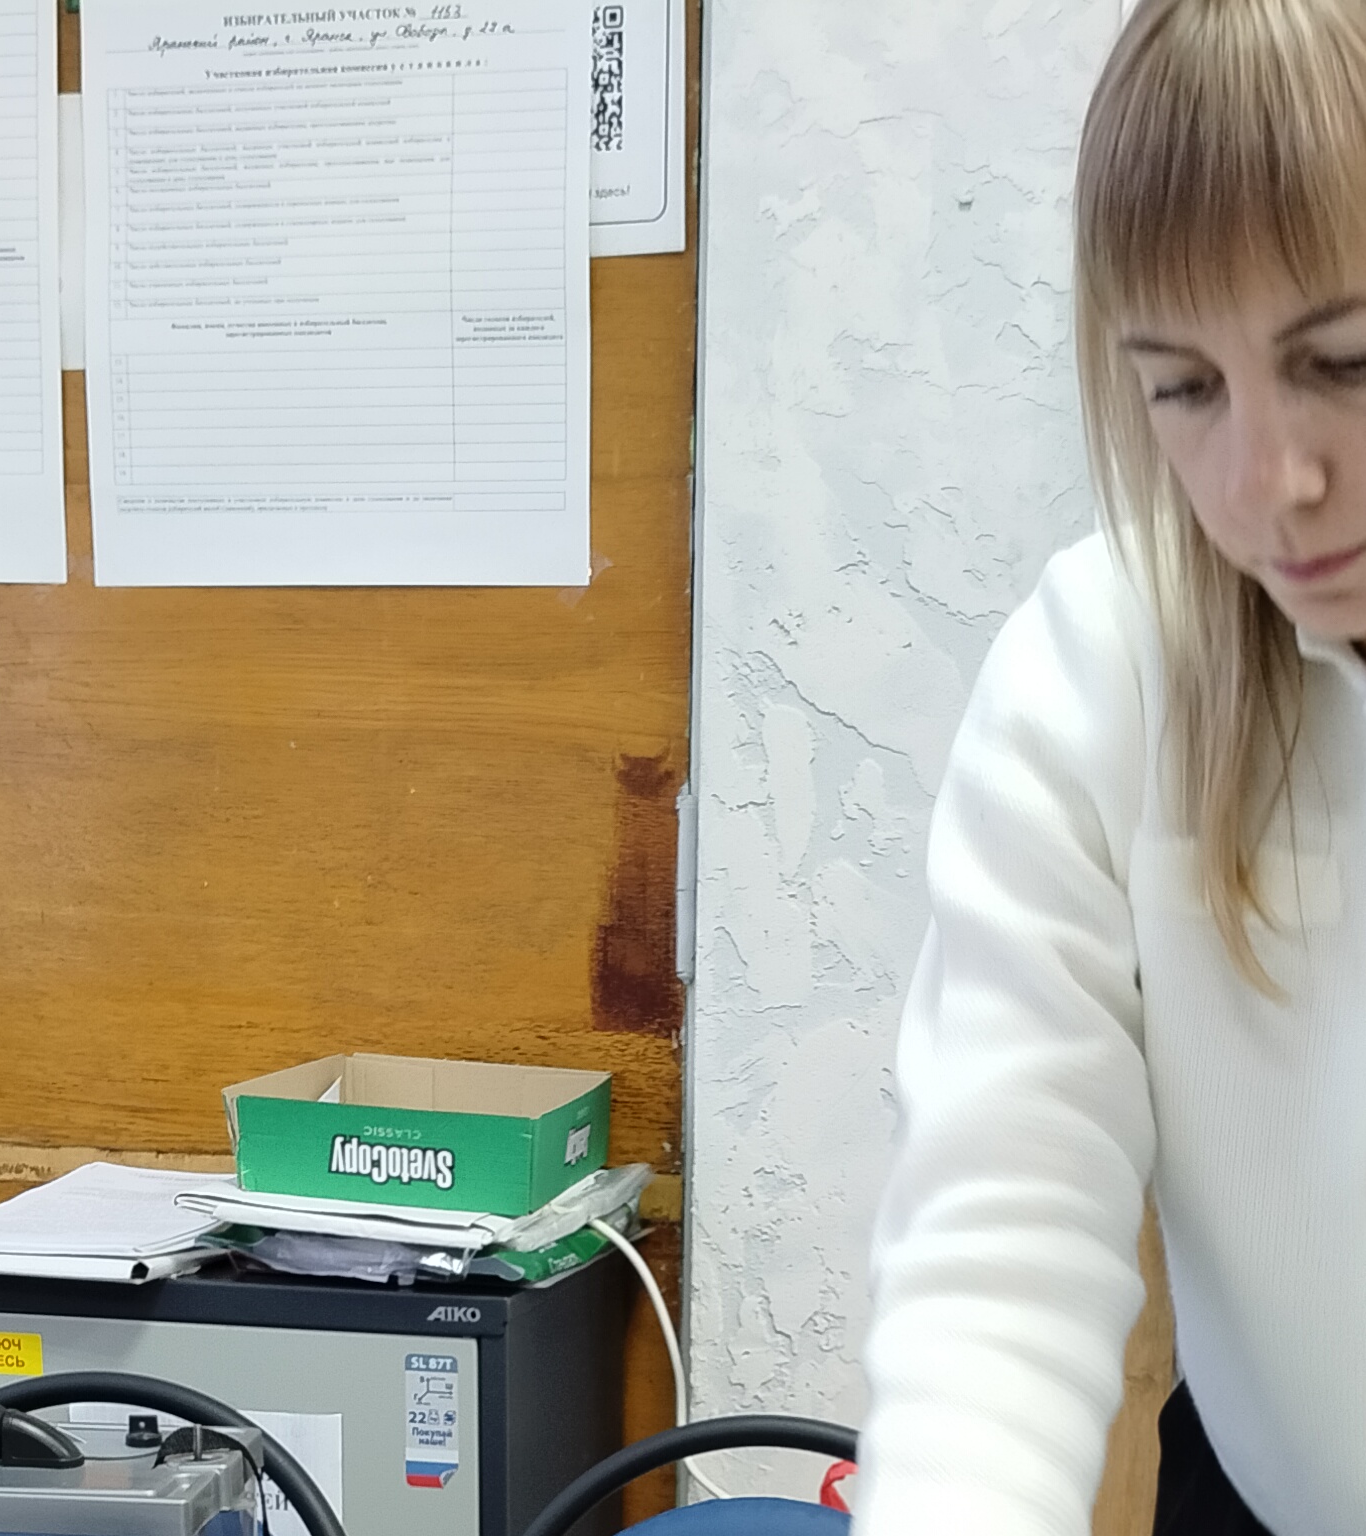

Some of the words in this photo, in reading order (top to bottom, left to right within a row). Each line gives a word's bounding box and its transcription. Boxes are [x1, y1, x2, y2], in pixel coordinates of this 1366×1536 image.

[339, 8, 400, 22] УЧАСТОК
[363, 1125, 422, 1140] CLASSIC
[330, 1135, 454, 1189] SvetoCopy
[427, 1306, 481, 1322] AIKO
[411, 1356, 427, 1369] SL
[428, 1358, 454, 1371] 87T
[408, 1411, 427, 1424] 22
[412, 1426, 453, 1441] Покупай
[418, 1436, 447, 1447] наше!
